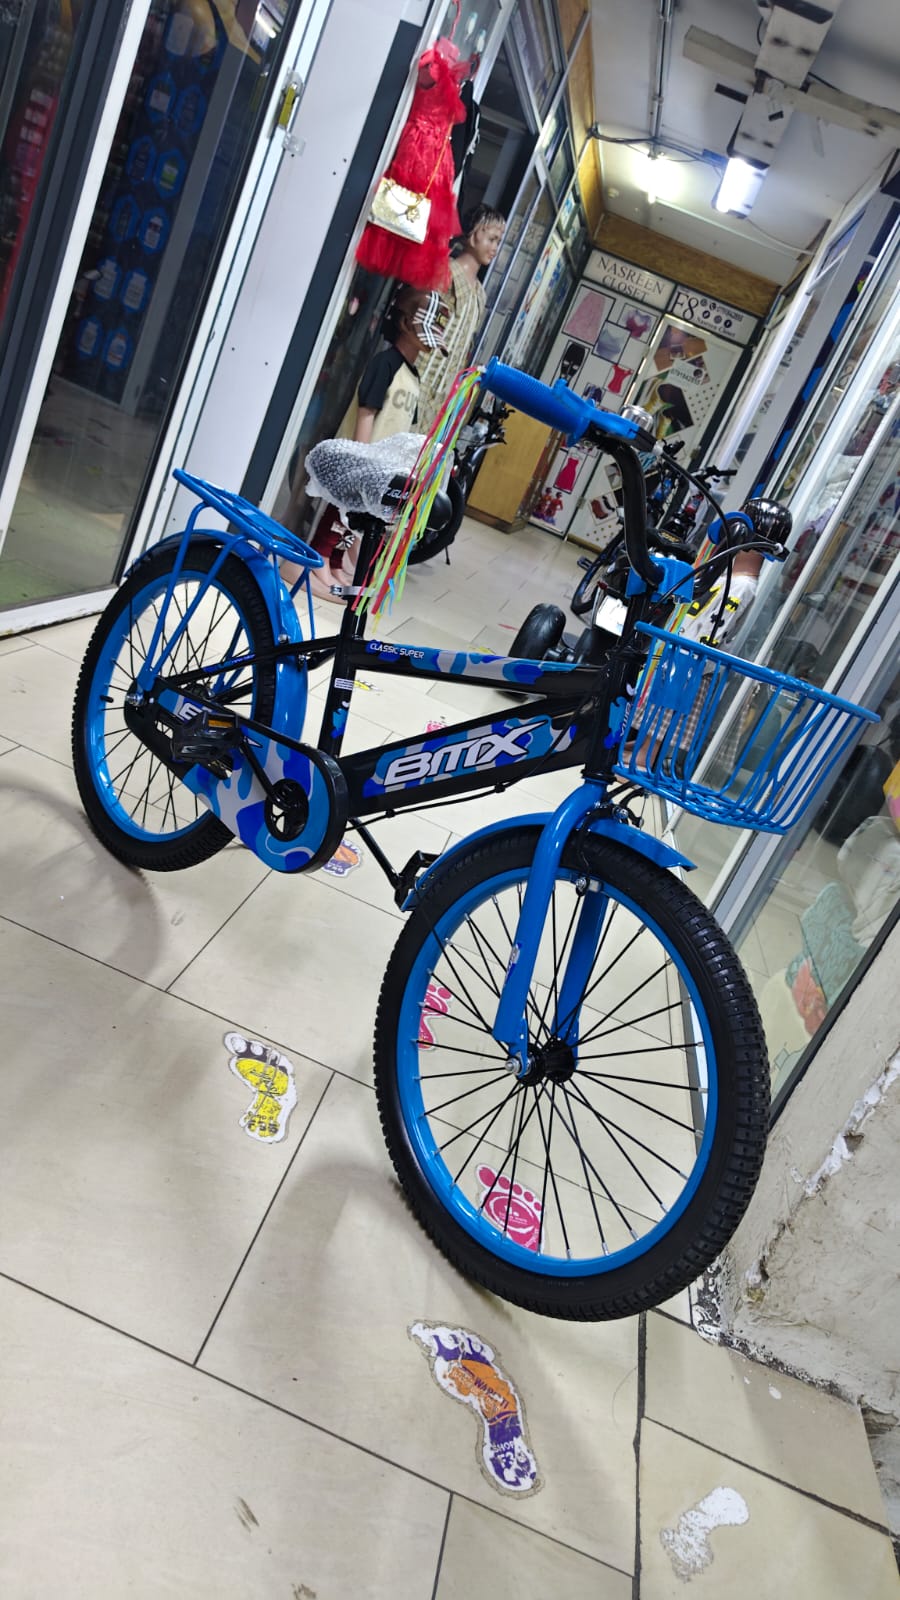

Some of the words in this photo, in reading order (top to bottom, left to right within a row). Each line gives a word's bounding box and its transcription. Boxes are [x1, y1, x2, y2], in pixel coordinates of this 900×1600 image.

[598, 256, 664, 295] NASREEN
[602, 275, 649, 300] CLOSET
[670, 291, 700, 320] F8
[370, 643, 398, 655] CLASSIC
[399, 648, 425, 659] SUPER
[383, 719, 549, 787] BMX
